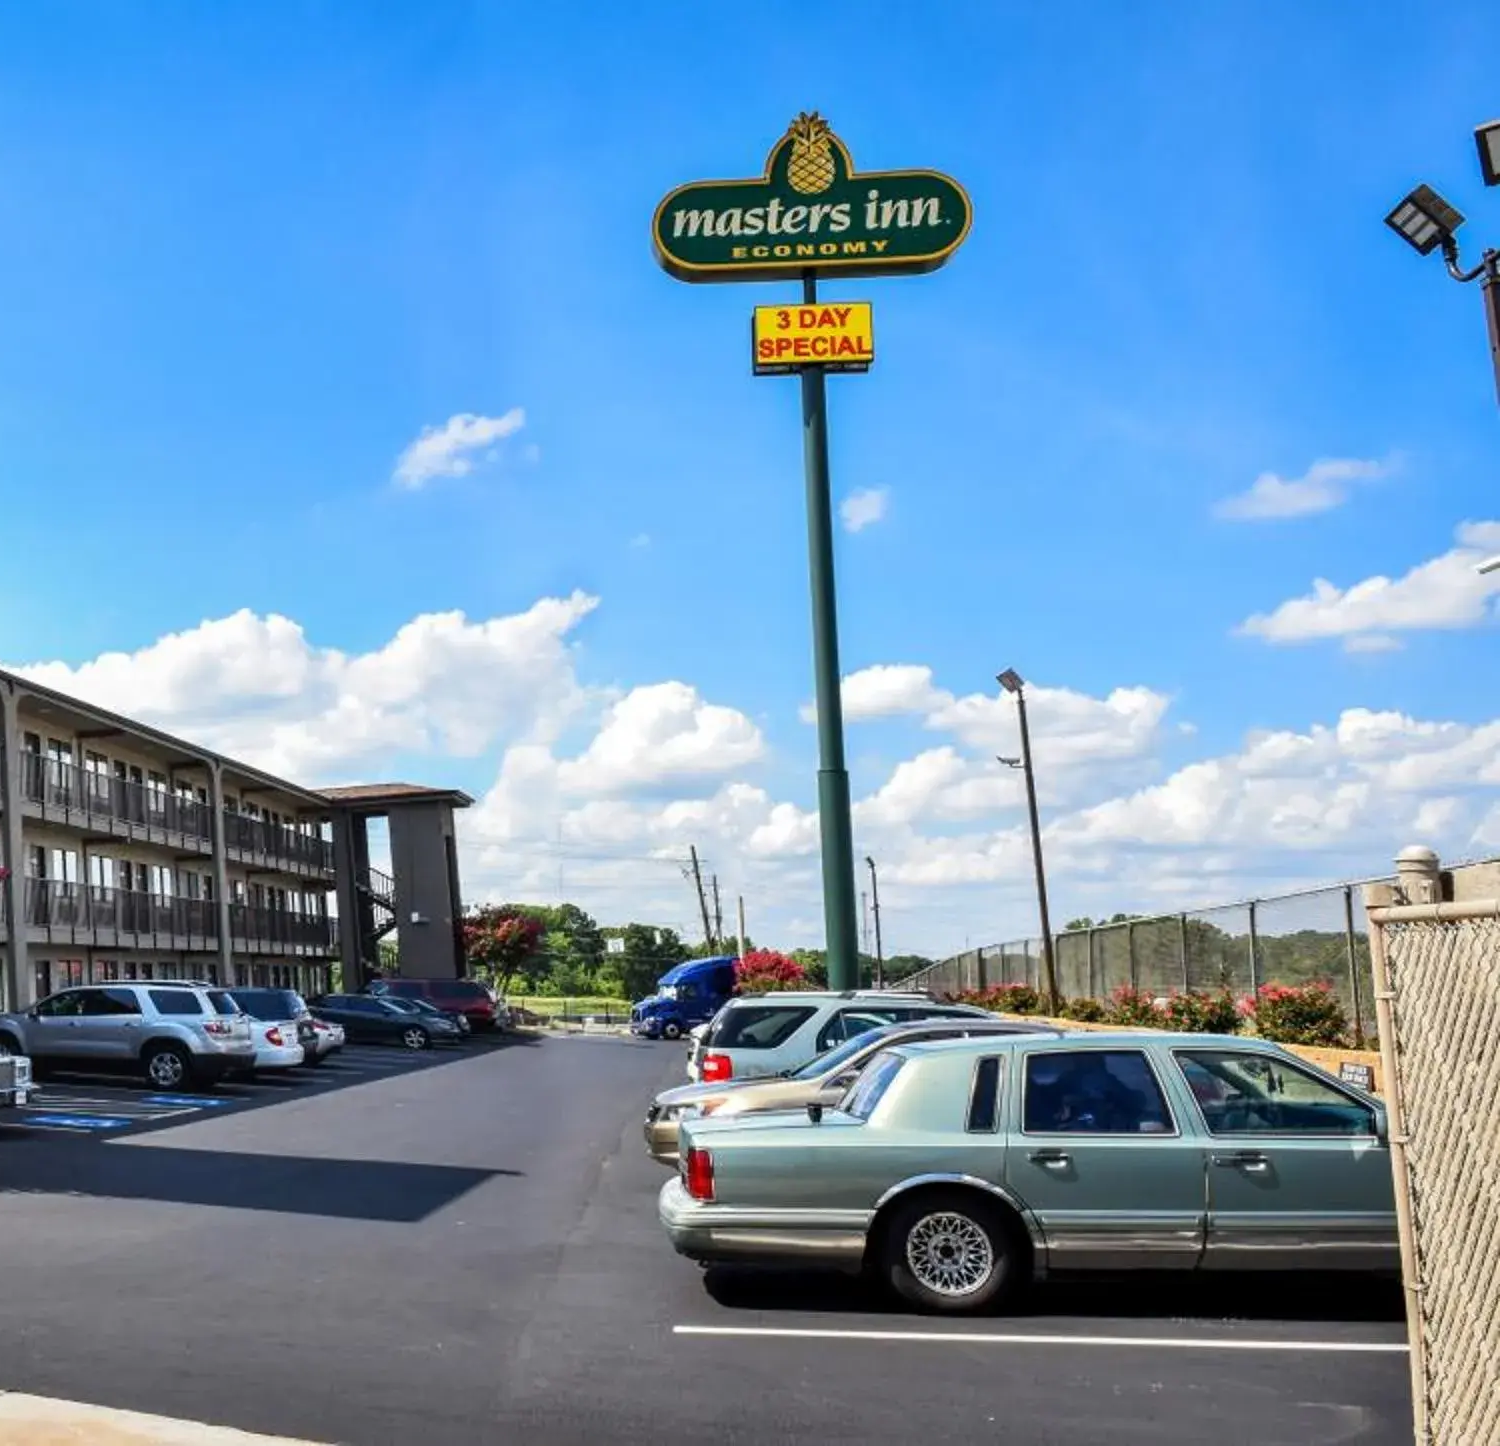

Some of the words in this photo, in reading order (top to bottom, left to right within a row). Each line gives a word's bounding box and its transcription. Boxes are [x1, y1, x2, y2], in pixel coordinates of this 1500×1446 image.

[672, 198, 851, 237] masters
[865, 189, 942, 230] inn
[732, 240, 889, 258] ECONOMY
[776, 310, 792, 330] 3
[799, 307, 852, 329] DAY
[758, 335, 872, 358] SPECIAL
